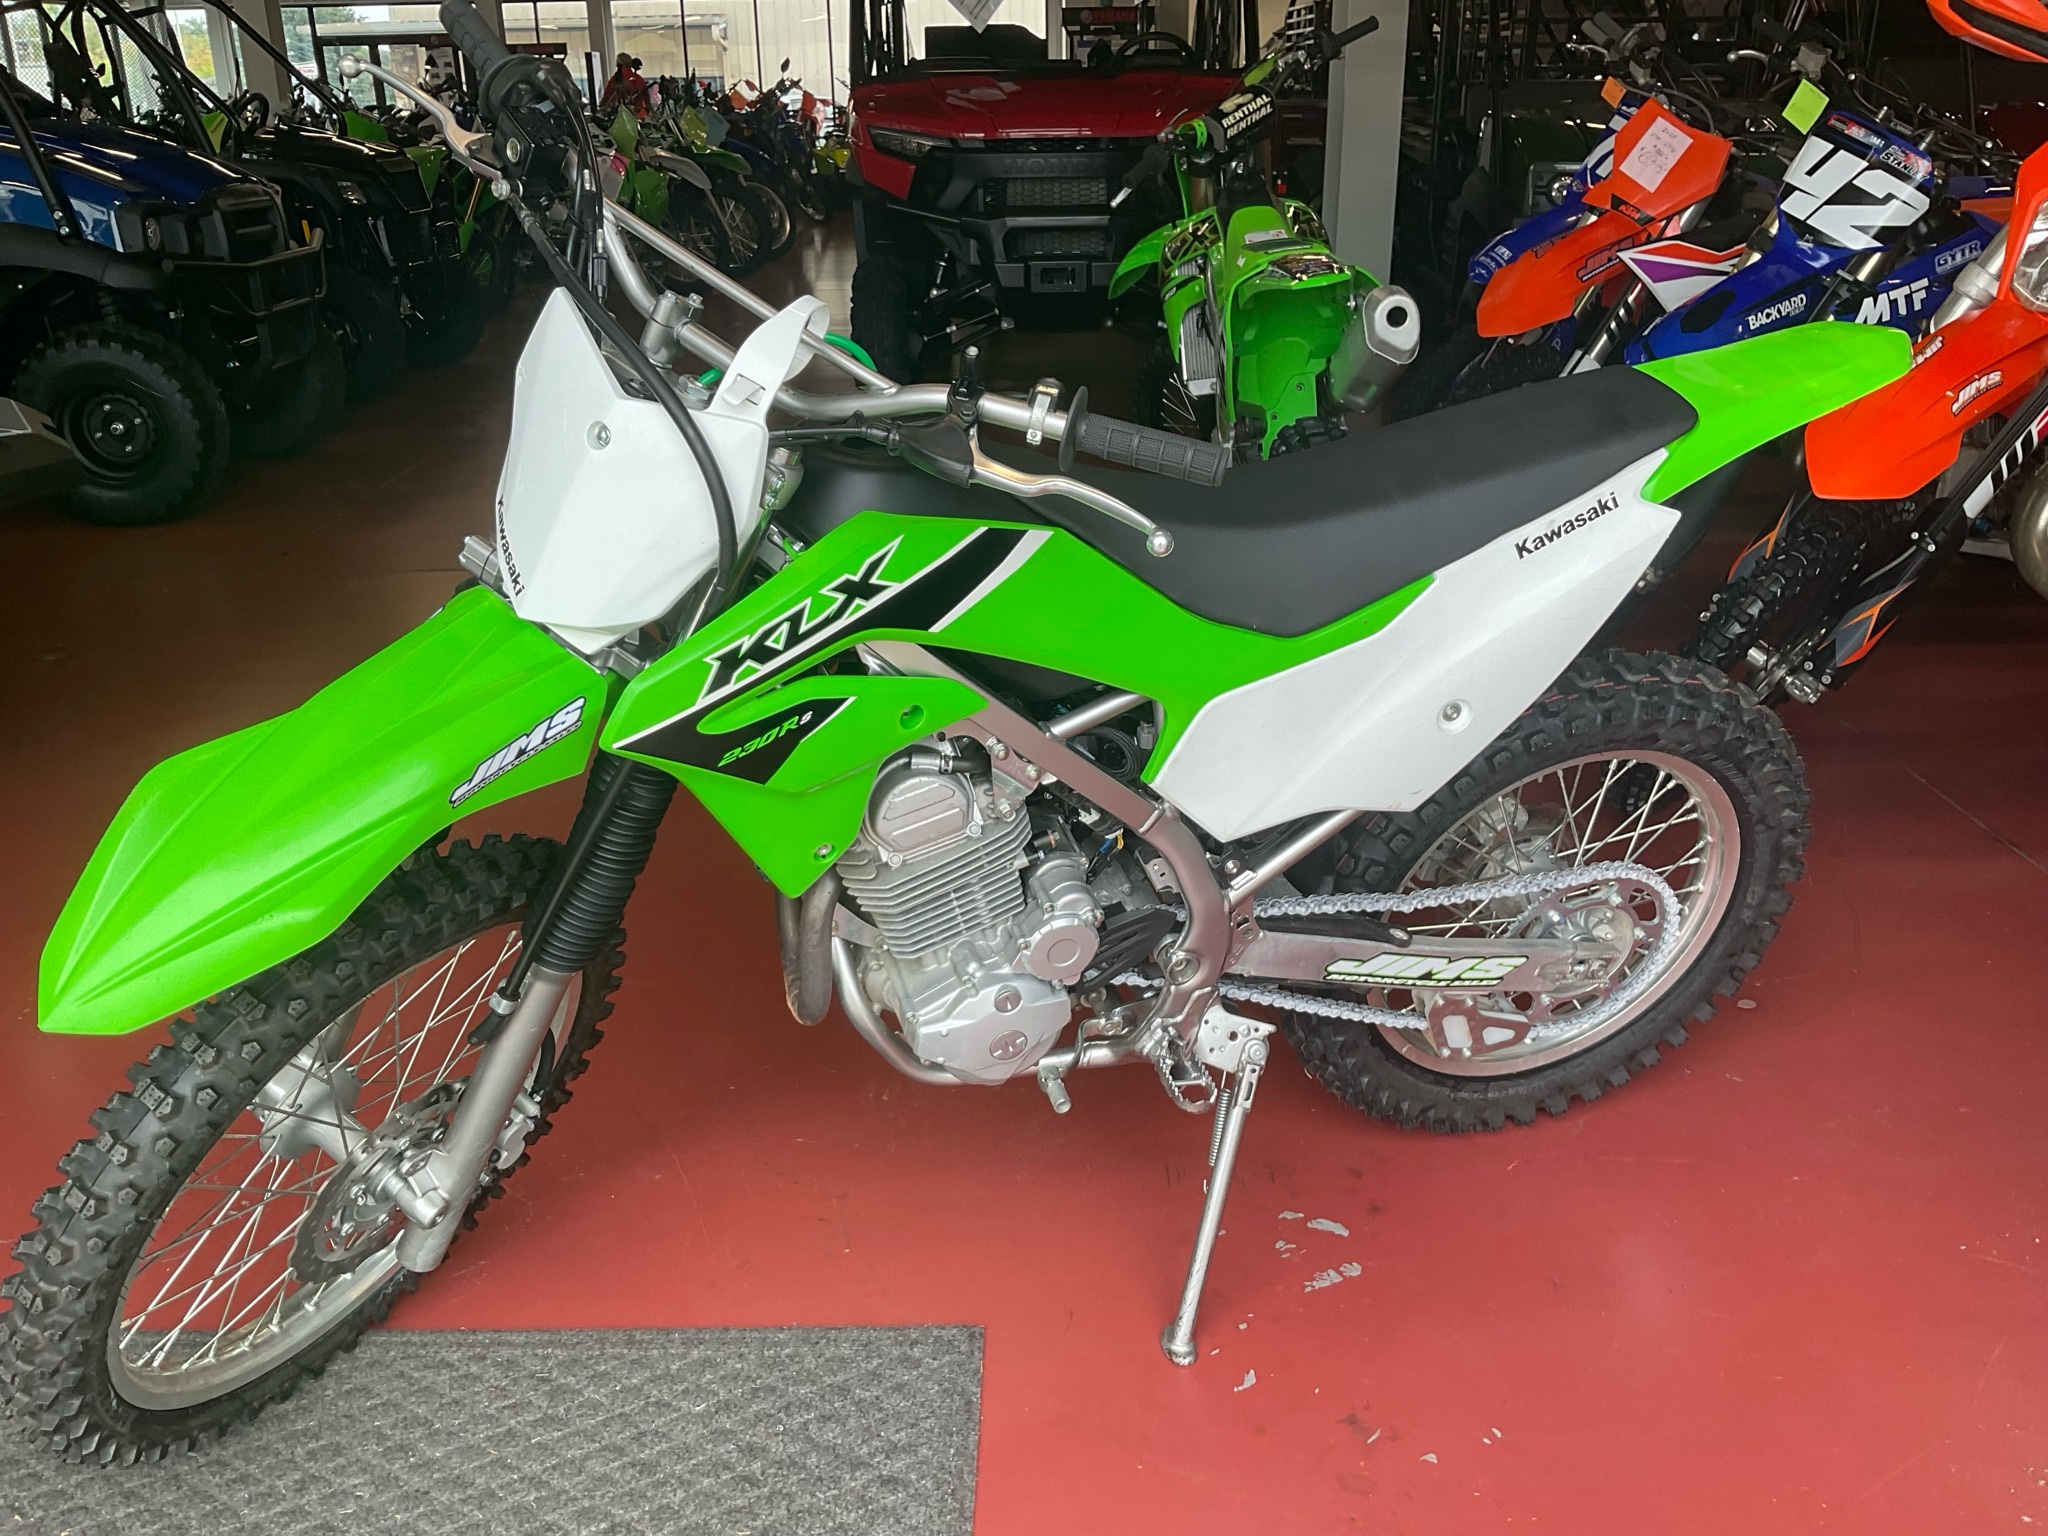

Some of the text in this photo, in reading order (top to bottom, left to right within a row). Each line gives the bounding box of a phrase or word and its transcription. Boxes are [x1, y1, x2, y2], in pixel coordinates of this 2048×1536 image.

[1221, 94, 1271, 128] RENTHAL
[1226, 104, 1273, 139] RENTHAL
[1617, 204, 1641, 220] KTM
[1780, 135, 1930, 249] 42
[1935, 241, 1981, 273] GYTR
[1745, 293, 1807, 330] BACKYARD
[1855, 277, 1929, 324] MTF
[1952, 370, 2002, 413] JIMS
[1514, 491, 1620, 560] Kawasaki
[498, 495, 525, 597] Kawasaki
[696, 535, 904, 704] KLX
[450, 697, 586, 802] JIMS
[1325, 973, 1451, 987] MOTORCYCLE
[1327, 953, 1528, 980] JIMS
